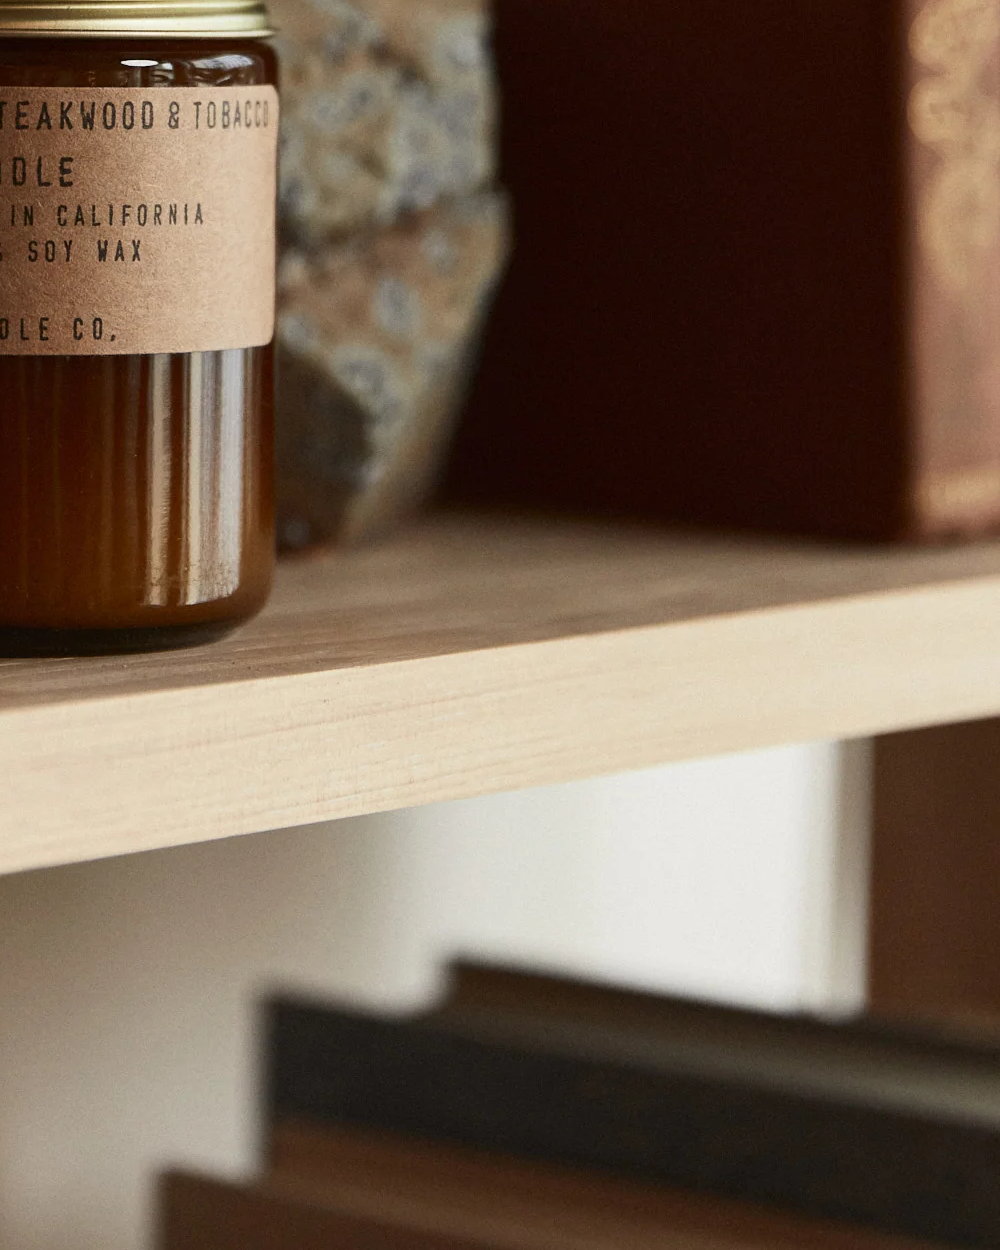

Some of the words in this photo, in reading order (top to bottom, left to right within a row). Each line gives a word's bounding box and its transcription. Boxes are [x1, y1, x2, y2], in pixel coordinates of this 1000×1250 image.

[168, 100, 180, 129] &
[193, 100, 269, 129] TOBACCO
[10, 204, 35, 227] IN
[57, 203, 205, 227] CALIFORNIA
[28, 240, 73, 263] SOY
[98, 239, 143, 262] WAX
